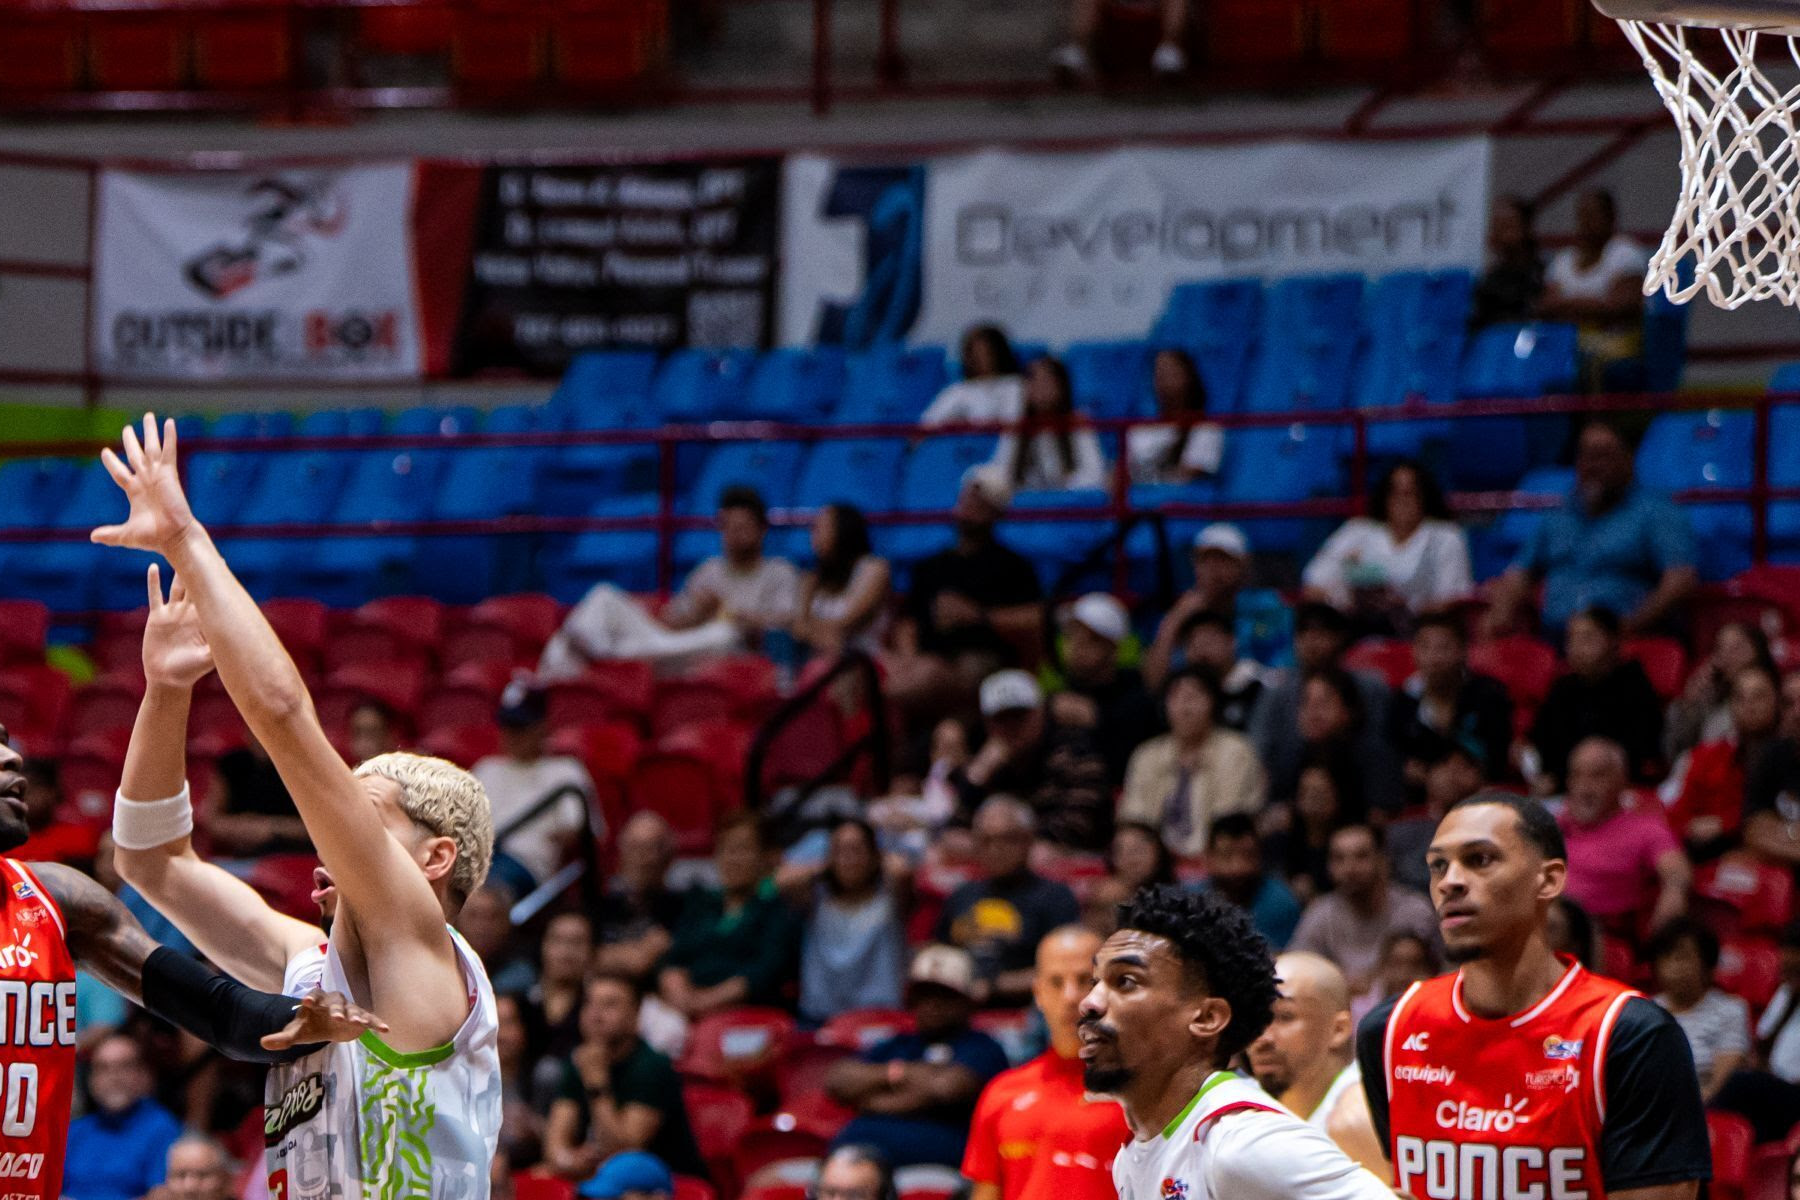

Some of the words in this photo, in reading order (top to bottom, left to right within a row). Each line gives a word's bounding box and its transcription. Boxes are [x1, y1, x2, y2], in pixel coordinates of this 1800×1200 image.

[956, 196, 1457, 267] Development
[112, 308, 276, 356] OUTSIDE
[1395, 1063, 1456, 1087] equiply
[1435, 1099, 1516, 1133] Claro
